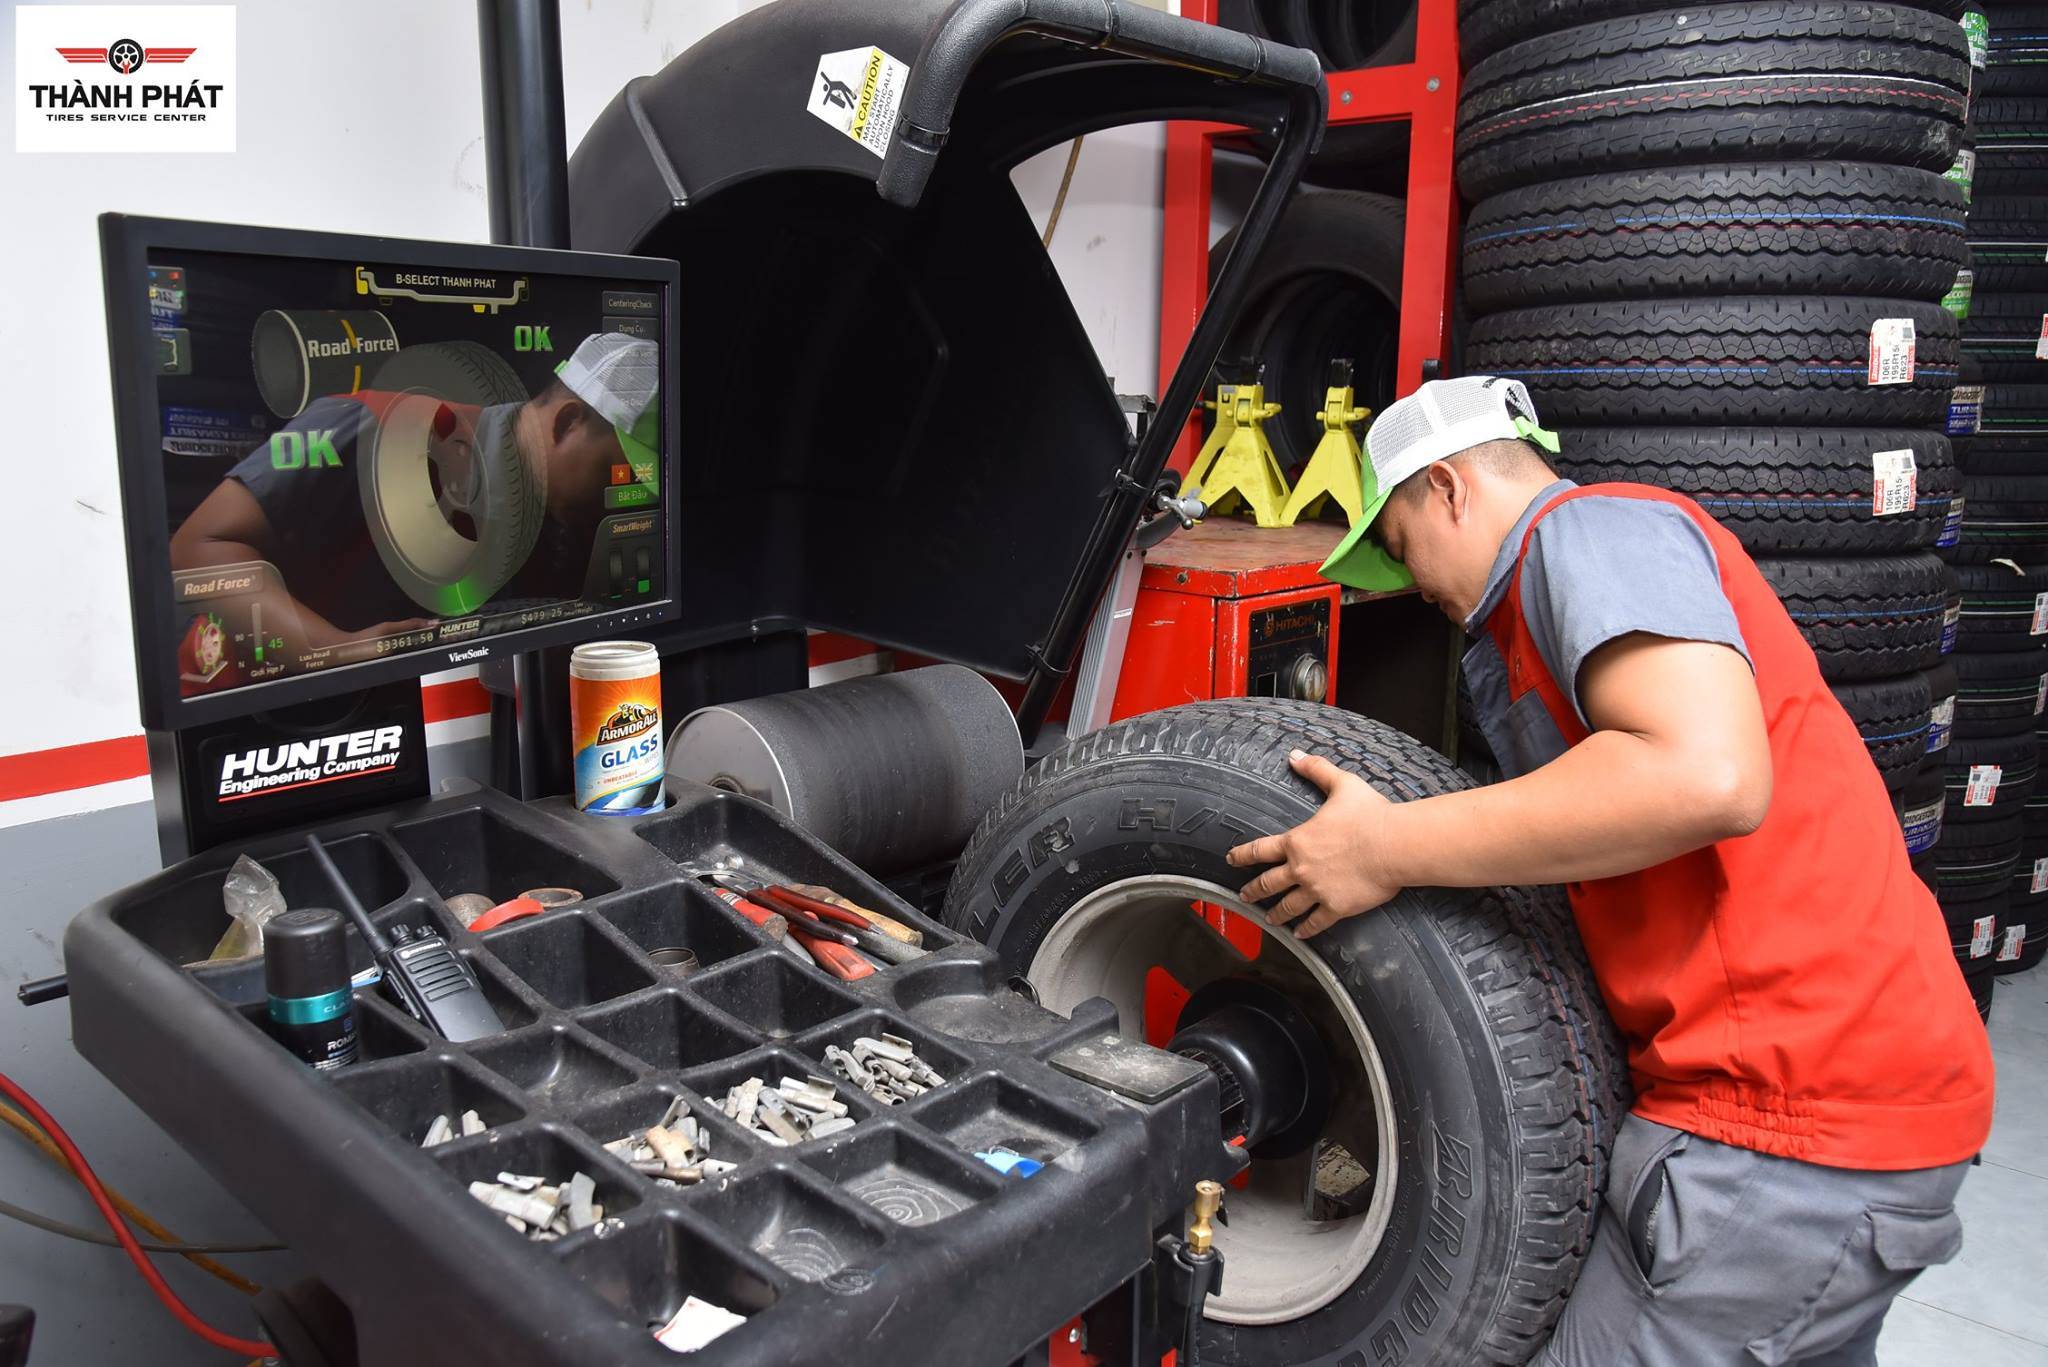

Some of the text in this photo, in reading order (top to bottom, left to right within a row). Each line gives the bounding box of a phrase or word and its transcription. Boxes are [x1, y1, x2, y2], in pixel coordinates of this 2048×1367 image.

[858, 55, 881, 121] CAUTION
[869, 65, 894, 145] AUTOMATICALLY
[862, 88, 881, 141] MAY START
[874, 89, 894, 149] UPON HOOD
[880, 110, 895, 152] CLOSING
[396, 273, 497, 289] B-SELECT THANH PHAT
[308, 337, 395, 358] Road Force
[514, 325, 554, 352] OK
[270, 429, 343, 470] OK
[184, 577, 250, 595] Road Force
[440, 619, 480, 634] HUNTER
[1275, 614, 1316, 632] HITACHI
[268, 637, 284, 649] 45
[448, 646, 490, 662] ViewSonic
[221, 725, 403, 780] HUNTER
[601, 734, 658, 768] GLASS
[219, 751, 400, 795] Engineering Company
